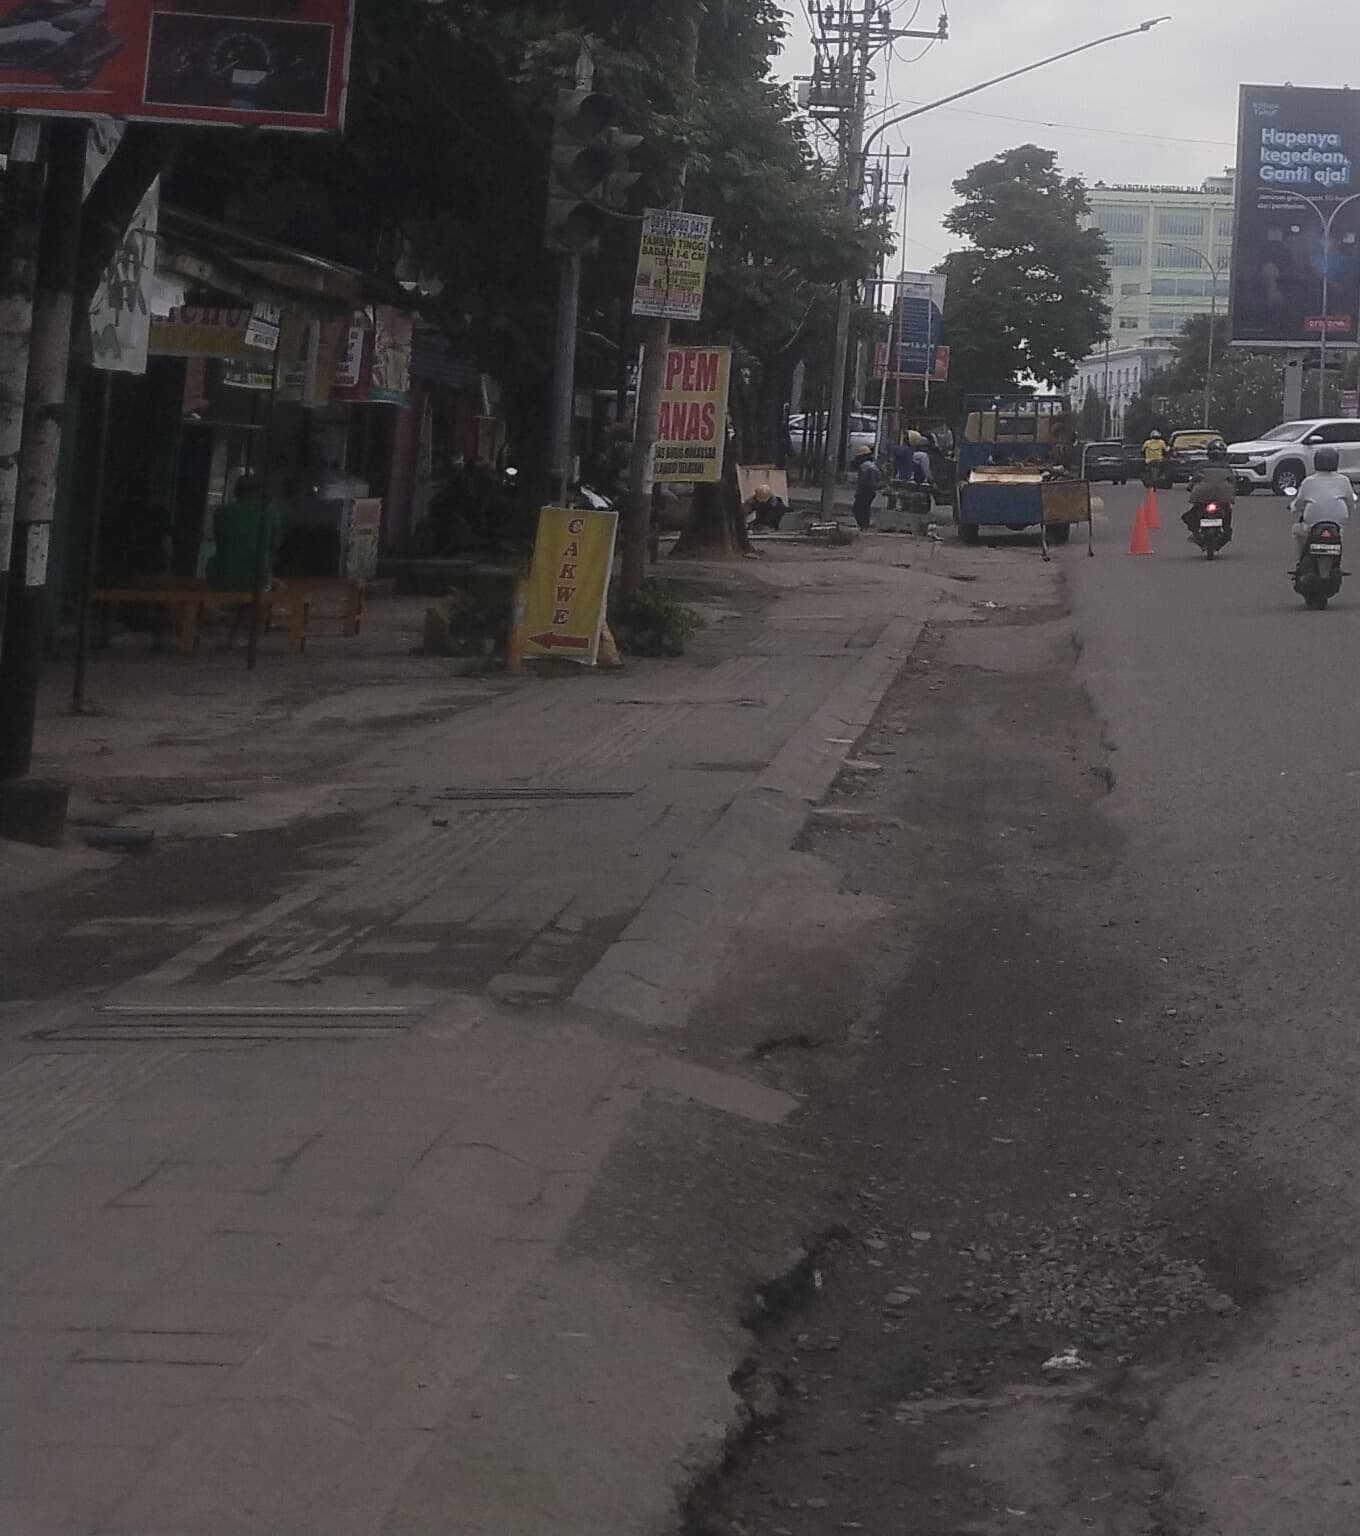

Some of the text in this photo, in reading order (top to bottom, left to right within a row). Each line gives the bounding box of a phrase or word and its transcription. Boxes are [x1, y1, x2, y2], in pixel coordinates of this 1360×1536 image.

[1261, 127, 1340, 149] Hapenya
[1259, 165, 1349, 185] Ganti aja!
[665, 352, 719, 392] PEM
[551, 518, 585, 625] CAKWE
